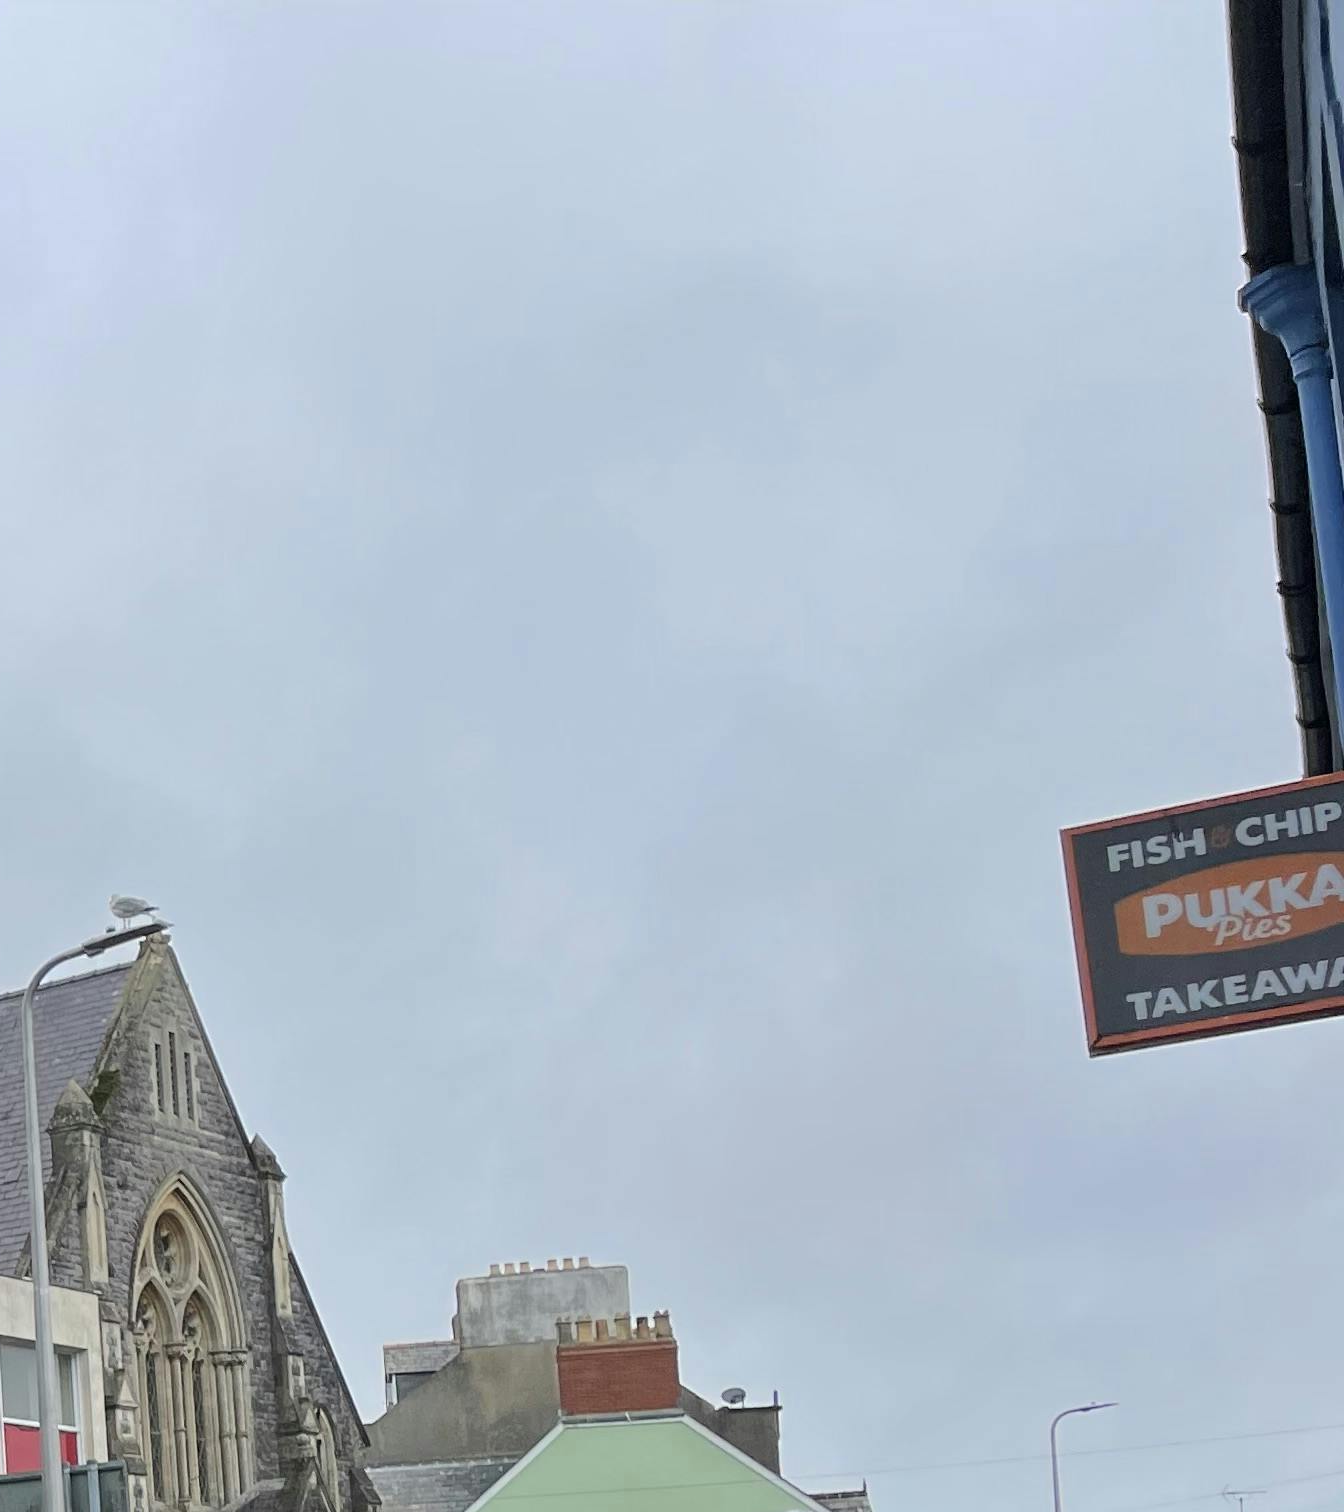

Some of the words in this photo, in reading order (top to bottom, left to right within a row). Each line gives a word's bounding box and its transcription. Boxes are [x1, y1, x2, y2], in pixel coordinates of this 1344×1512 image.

[1107, 827, 1207, 873] FISH
[1142, 863, 1344, 939] PUKKA
[1207, 913, 1292, 946] Pies
